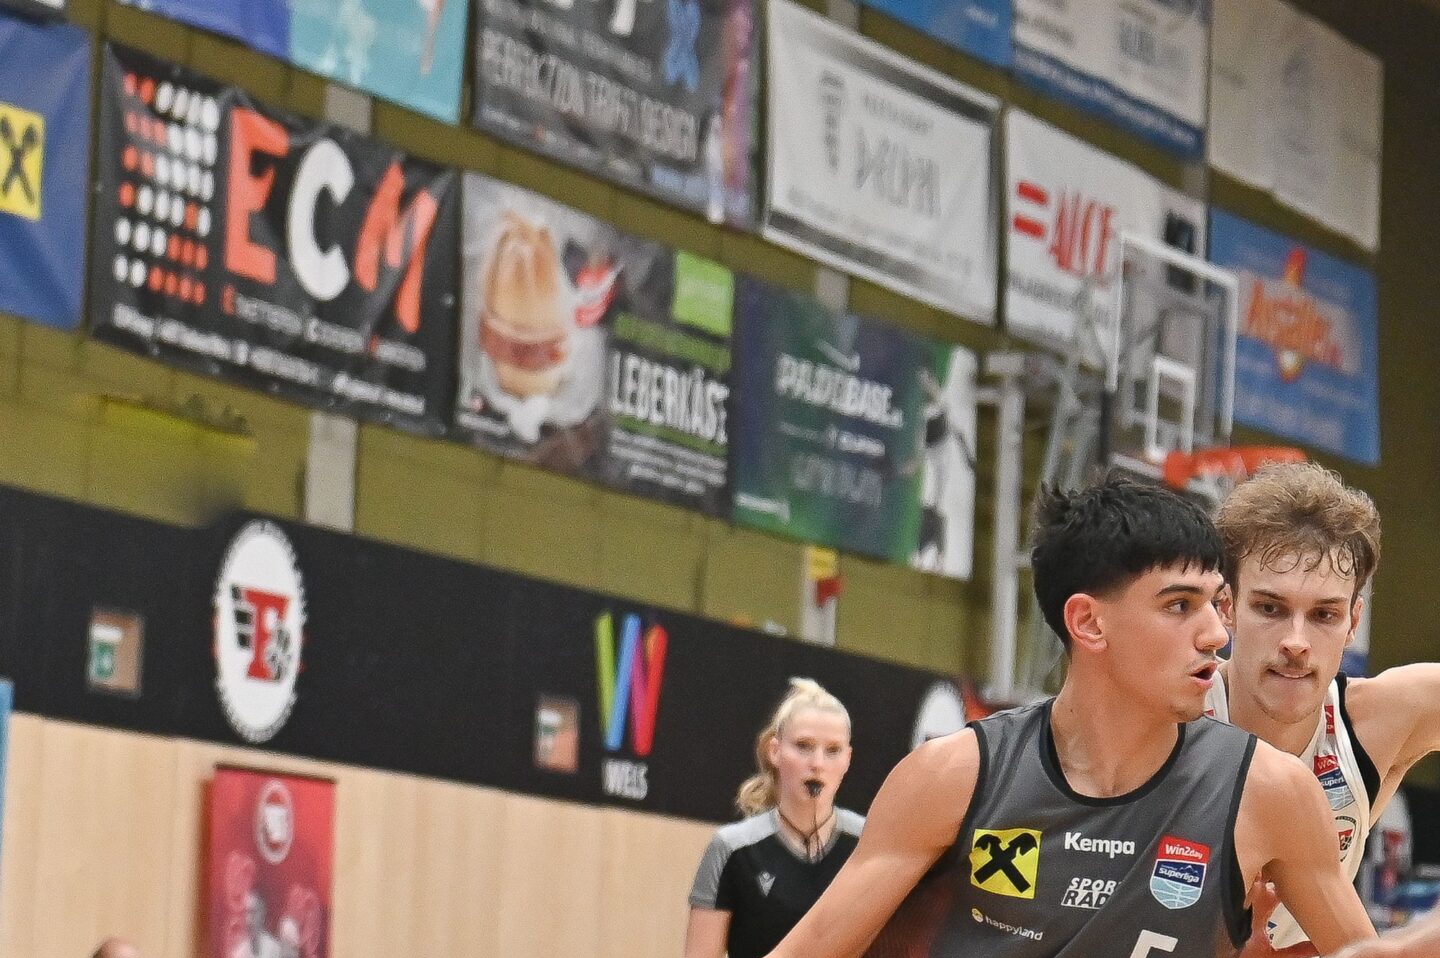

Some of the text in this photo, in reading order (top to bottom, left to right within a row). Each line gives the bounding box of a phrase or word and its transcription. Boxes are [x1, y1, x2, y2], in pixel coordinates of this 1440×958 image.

[223, 106, 439, 335] ECM
[1064, 831, 1136, 859] Kempa
[1068, 877, 1122, 895] SPOR
[1158, 866, 1200, 883] superliga
[984, 914, 1044, 941] happyland
